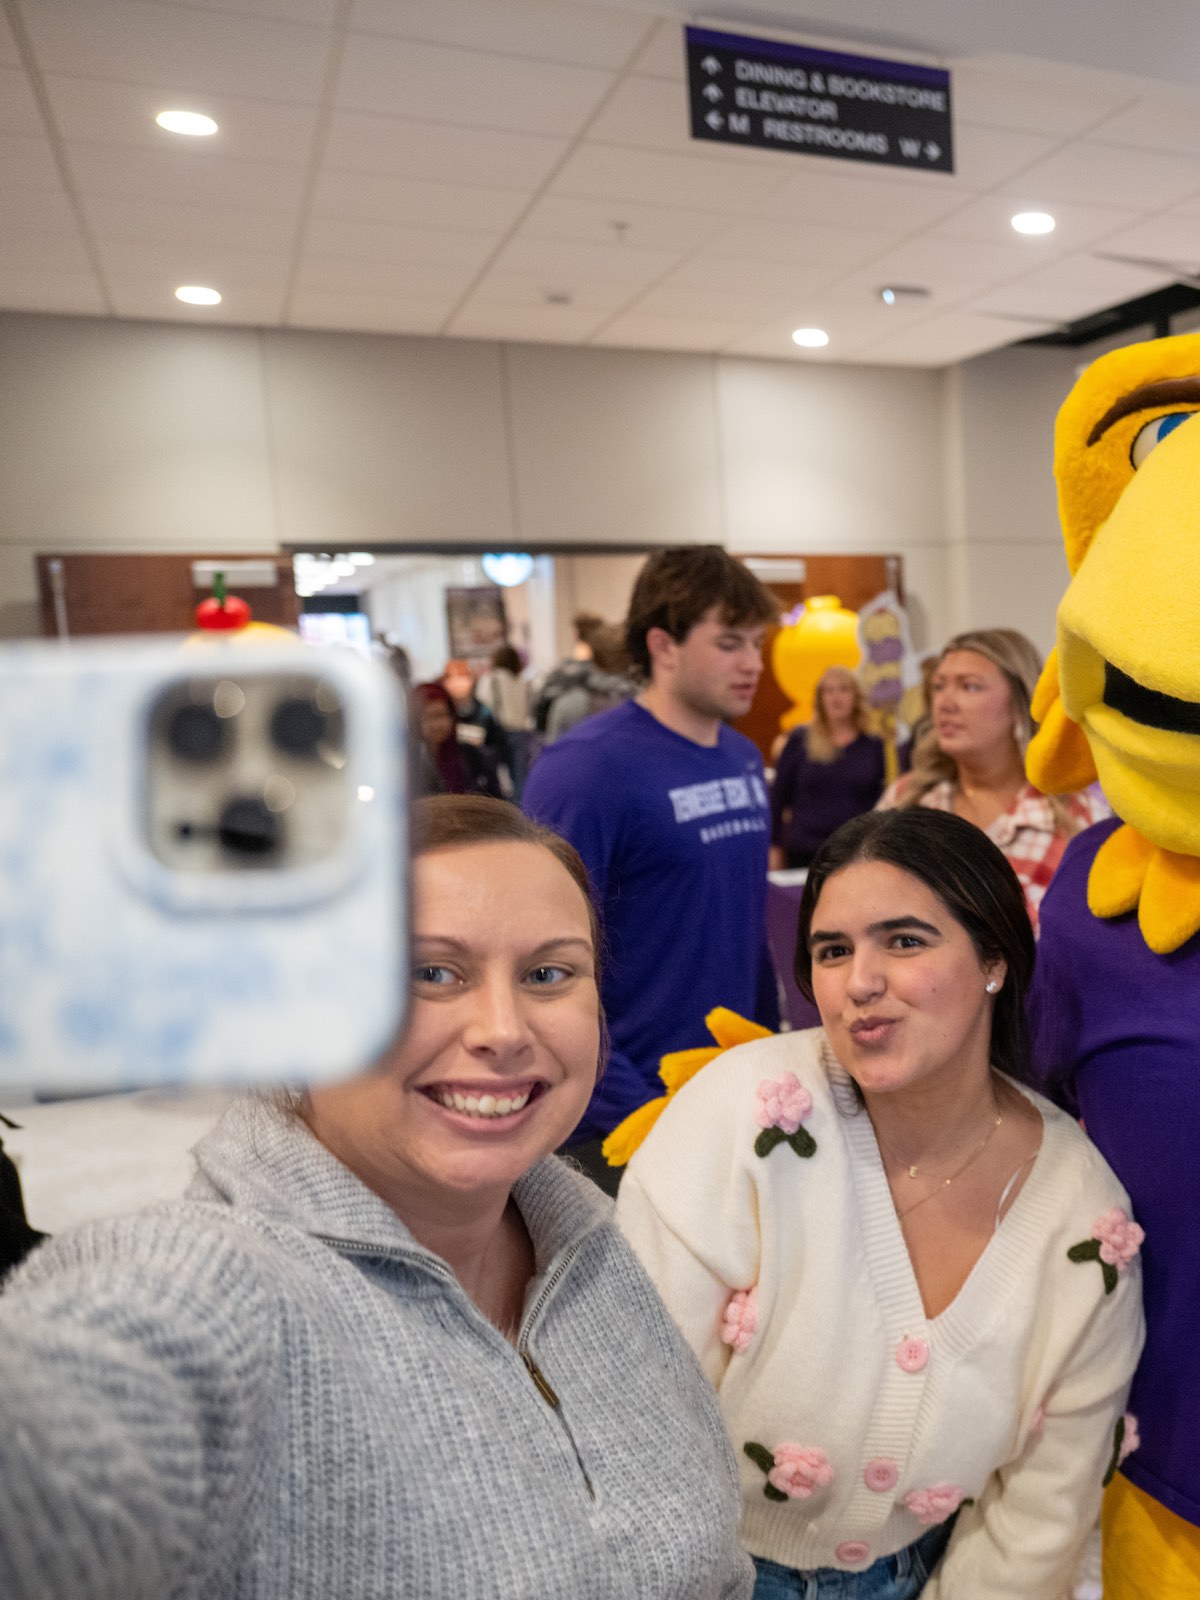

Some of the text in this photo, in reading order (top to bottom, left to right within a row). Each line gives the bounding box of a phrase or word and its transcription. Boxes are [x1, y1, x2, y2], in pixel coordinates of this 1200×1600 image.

[735, 60, 807, 90] DINING
[827, 74, 947, 112] BOOKSTORE
[735, 87, 839, 120] ELEVATOR
[728, 113, 750, 135] M
[763, 118, 889, 154] RESTROOMS
